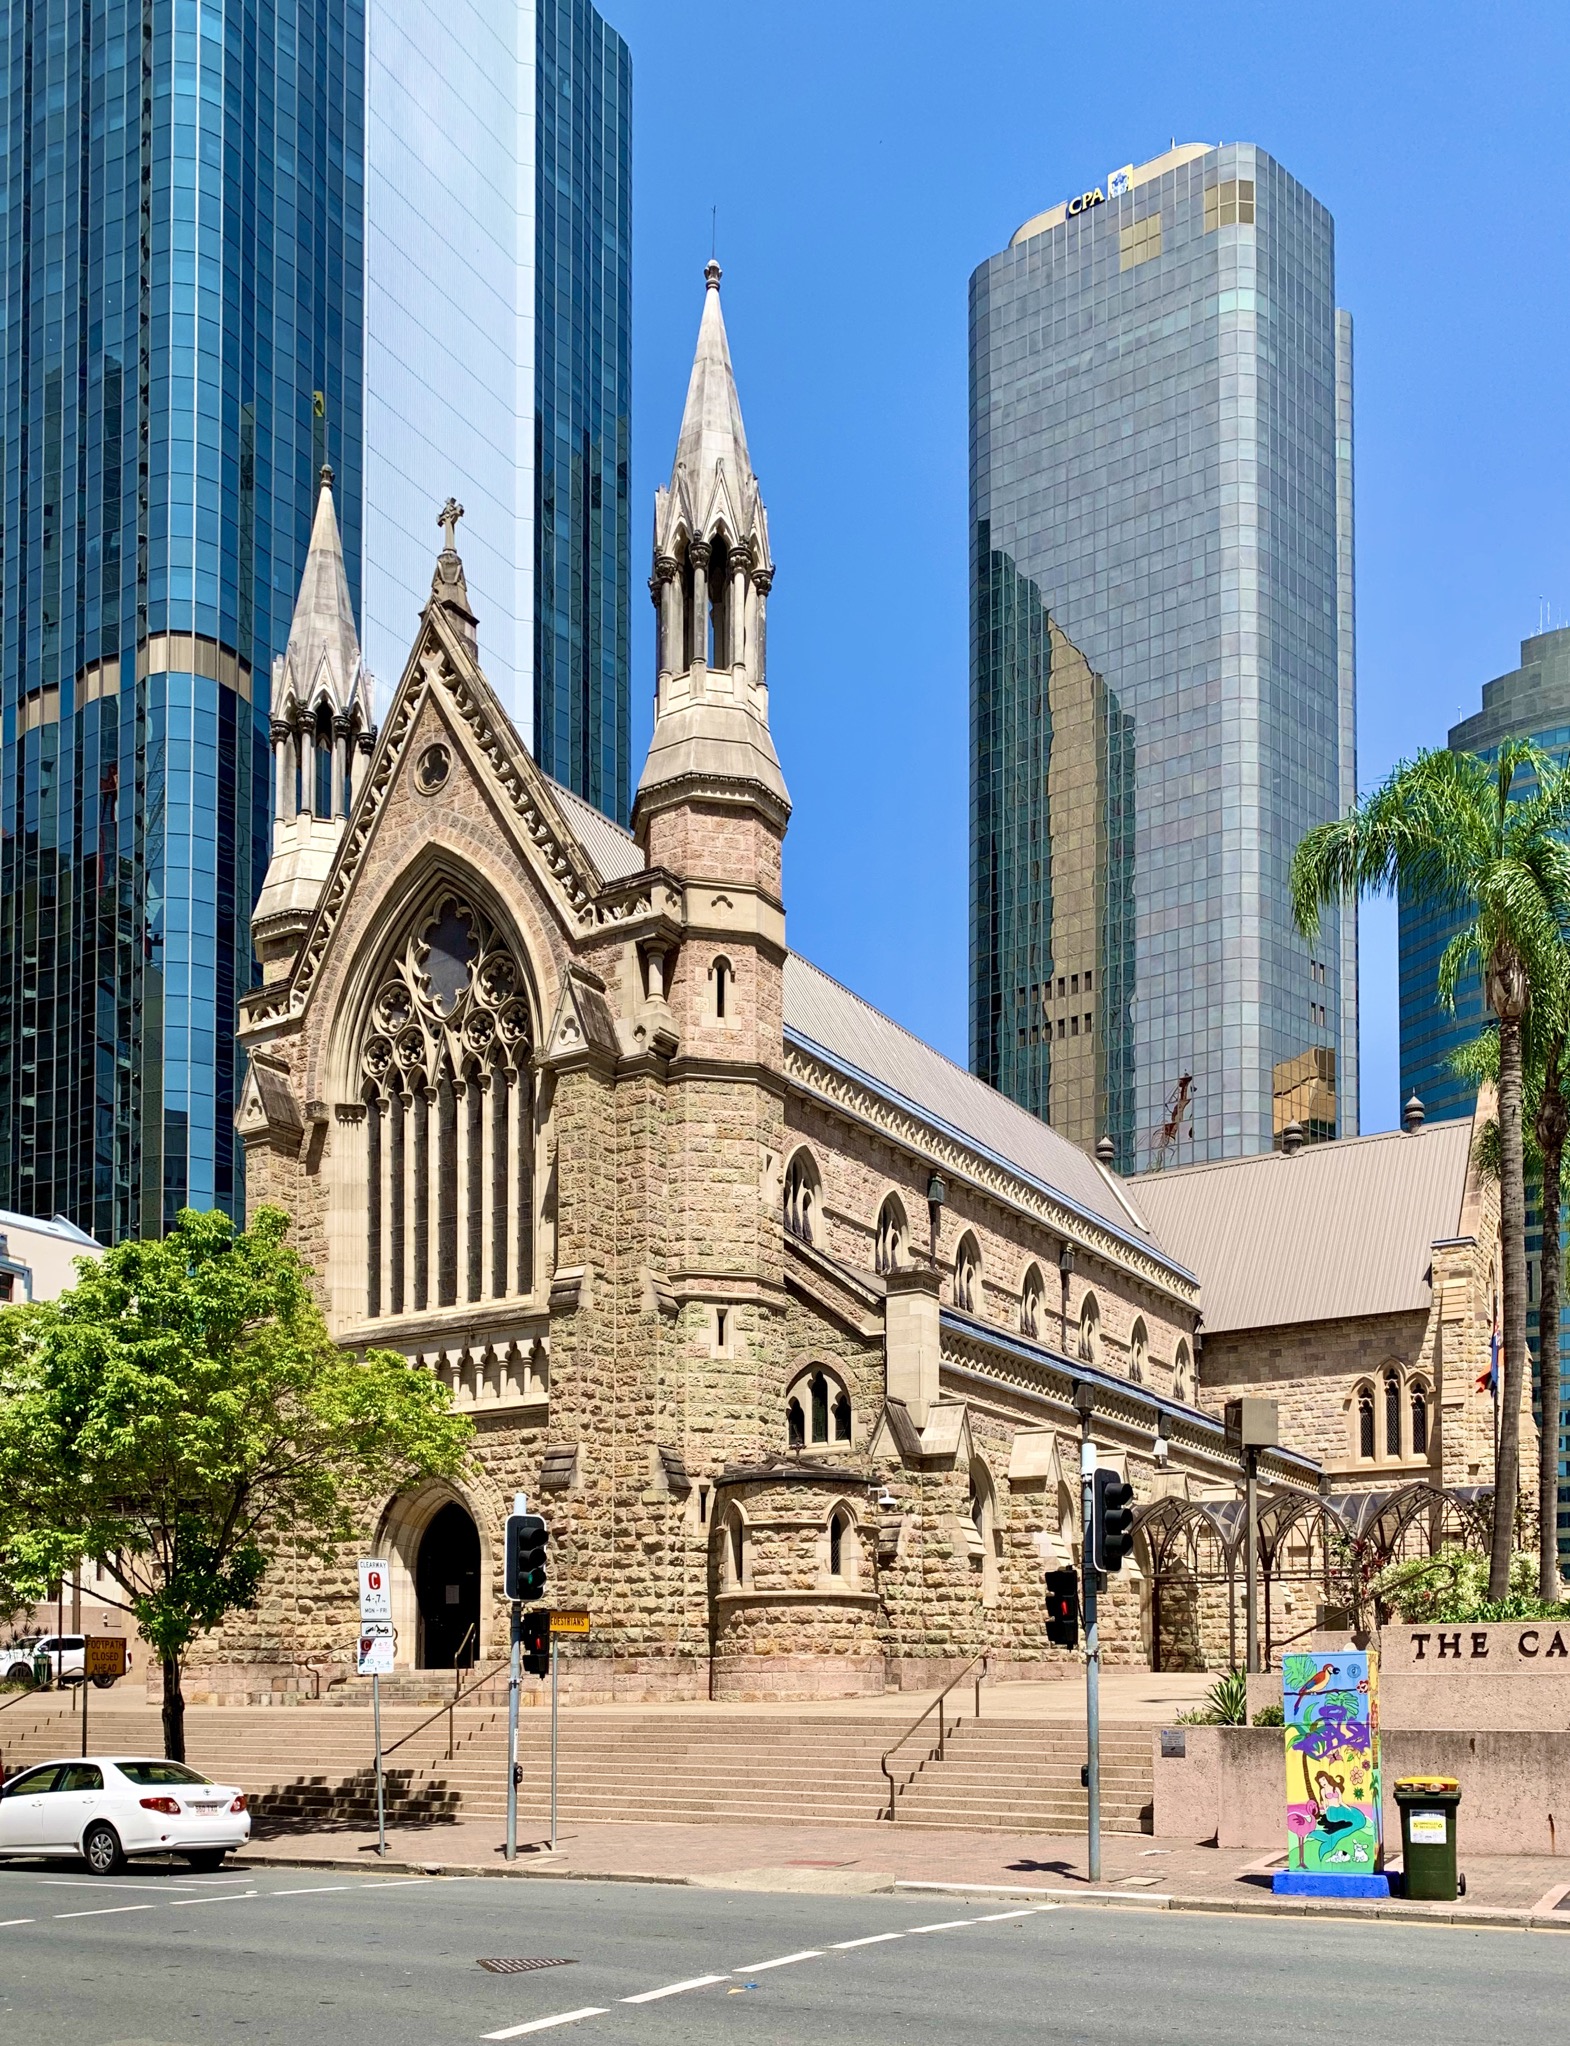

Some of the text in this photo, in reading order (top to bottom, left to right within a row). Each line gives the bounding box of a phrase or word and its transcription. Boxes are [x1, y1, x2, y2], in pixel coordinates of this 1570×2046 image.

[1068, 187, 1105, 215] CPA
[360, 1561, 387, 1569] CLEARWAY
[371, 1573, 379, 1589] C
[551, 1617, 584, 1626] EDESTRIANS
[86, 1640, 124, 1649] FOOTPATH
[1410, 1630, 1569, 1659] THE CA
[91, 1652, 119, 1661] CLOSED
[93, 1663, 117, 1672] AHEAD
